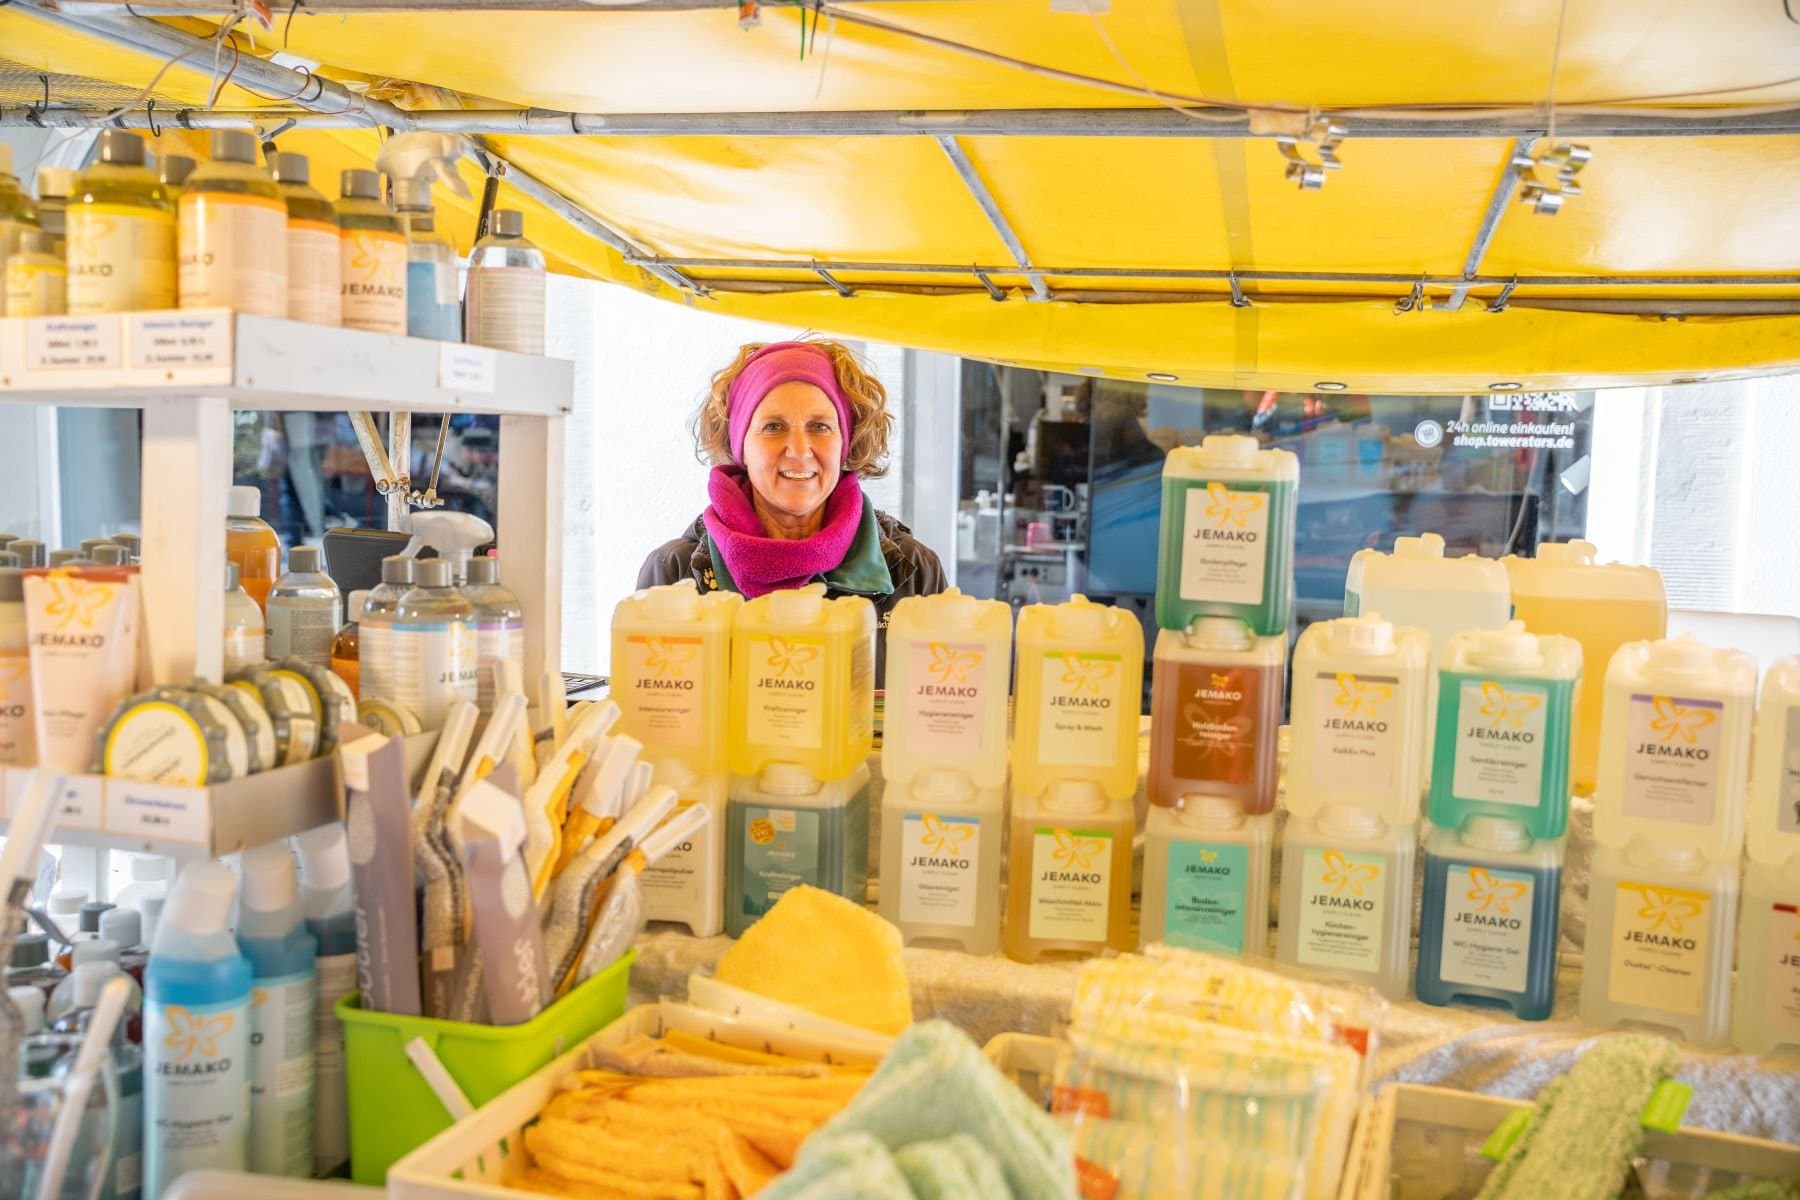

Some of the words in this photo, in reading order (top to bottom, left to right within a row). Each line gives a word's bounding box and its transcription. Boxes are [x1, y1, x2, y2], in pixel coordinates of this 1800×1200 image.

[341, 283, 404, 299] JEMAKO
[1446, 421, 1469, 433] 24h
[1471, 421, 1507, 434] online
[1509, 421, 1575, 436] einkaufen!
[1453, 434, 1574, 449] shop.towerstars.de
[1193, 528, 1257, 543] JEMAKO
[635, 678, 694, 690] JEMAKO
[757, 677, 815, 691] JEMAKO
[917, 684, 978, 698] JEMAKO
[1049, 695, 1111, 709] JEMAKO
[1194, 689, 1242, 701] JEMAKO
[1323, 718, 1388, 733] JEMAKO
[1466, 727, 1535, 744] JEMAKO
[1635, 743, 1710, 761] JEMAKO
[910, 856, 970, 870] JEMAKO
[1184, 864, 1231, 876] JEMAKO
[1040, 871, 1102, 884] JEMAKO
[1310, 894, 1375, 912] JEMAKO
[1454, 911, 1523, 930] JEMAKO
[1624, 930, 1697, 951] JEMAKO
